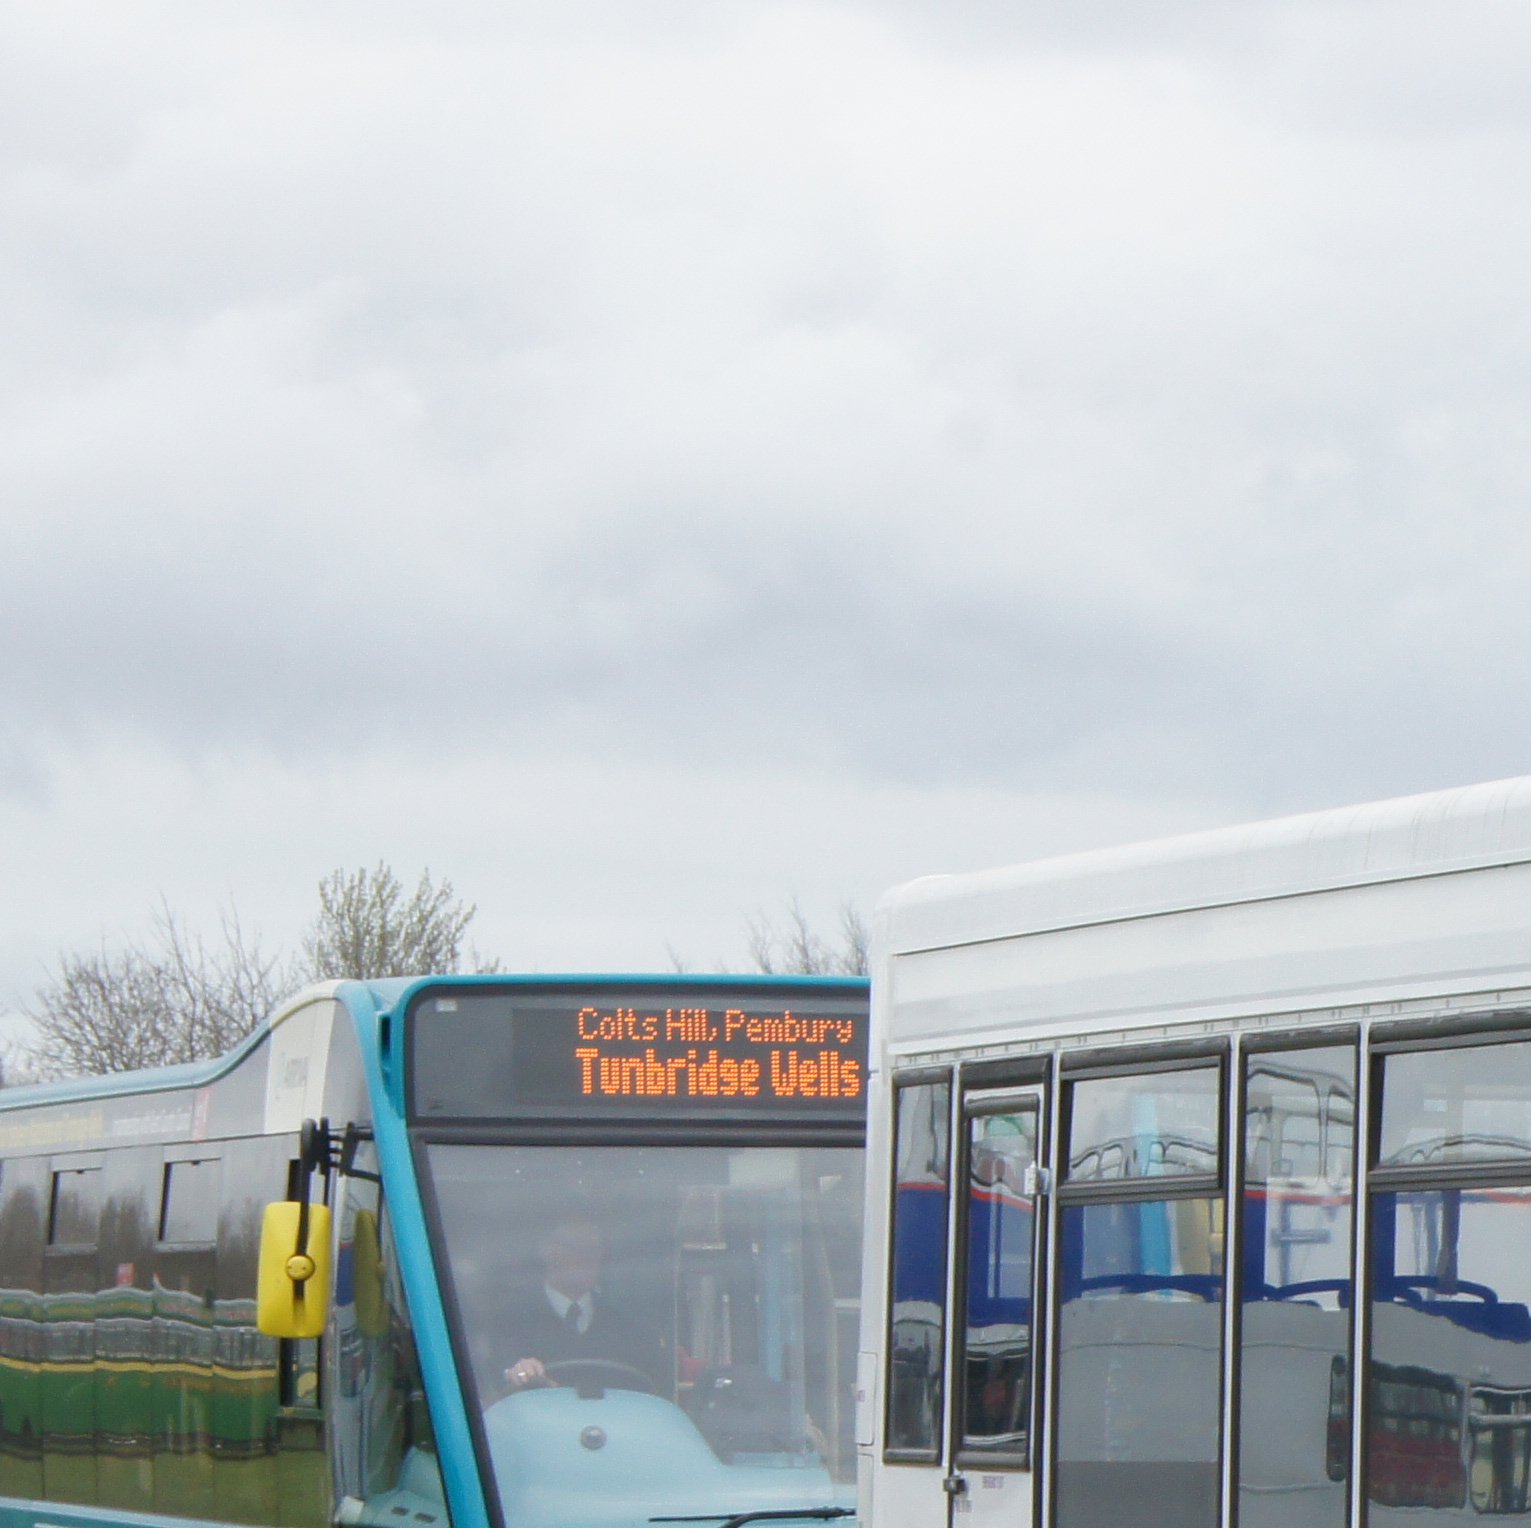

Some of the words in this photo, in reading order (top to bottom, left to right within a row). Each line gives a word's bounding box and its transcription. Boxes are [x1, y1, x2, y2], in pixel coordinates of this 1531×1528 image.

[578, 1007, 658, 1040] Colts
[666, 1008, 718, 1042] Hill,
[725, 1010, 852, 1043] Pembury
[576, 1048, 760, 1095] Tunbridge
[770, 1050, 860, 1097] Wells
